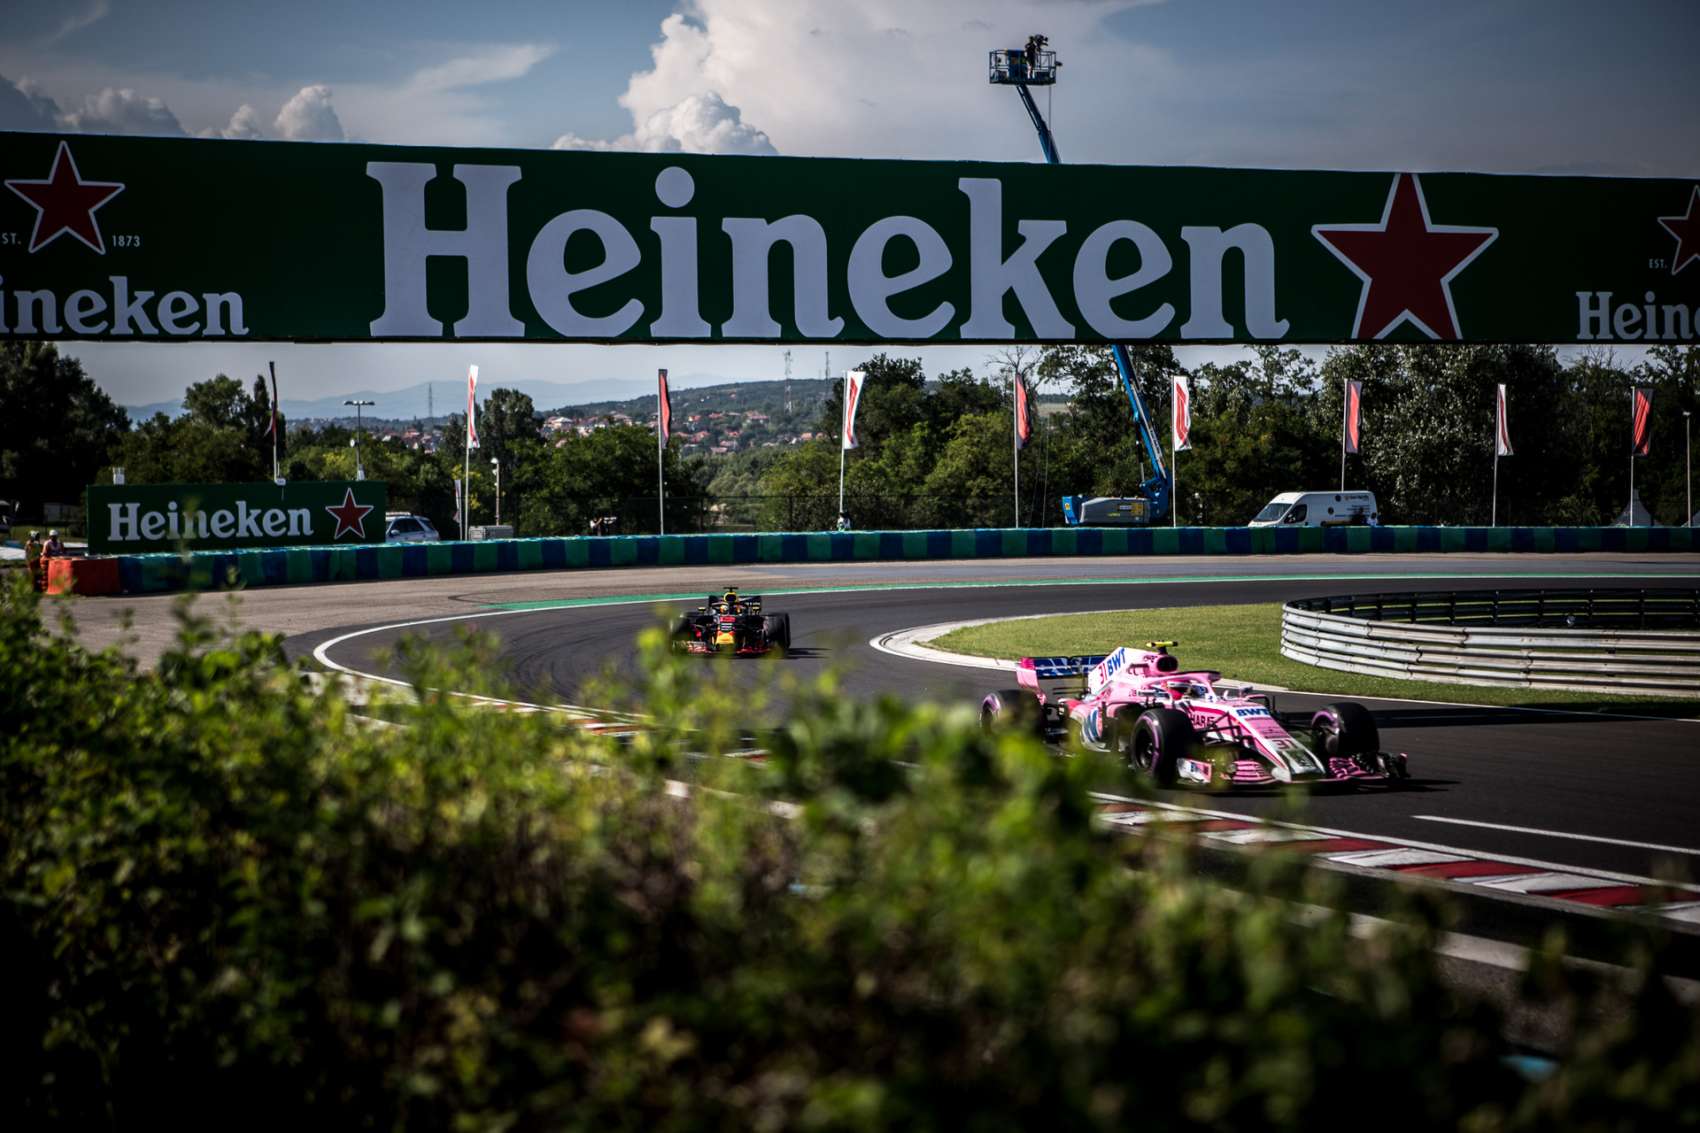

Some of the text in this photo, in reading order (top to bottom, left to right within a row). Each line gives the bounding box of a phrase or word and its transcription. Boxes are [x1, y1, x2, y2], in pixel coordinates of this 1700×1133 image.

[112, 235, 141, 247] 1873
[366, 161, 1290, 339] Heineken
[1648, 258, 1668, 269] EST.
[1576, 290, 1700, 340] Hein
[107, 501, 314, 542] Heineken
[1107, 648, 1126, 676] BWT
[1236, 708, 1269, 716] BWT
[1272, 739, 1298, 750] 31
